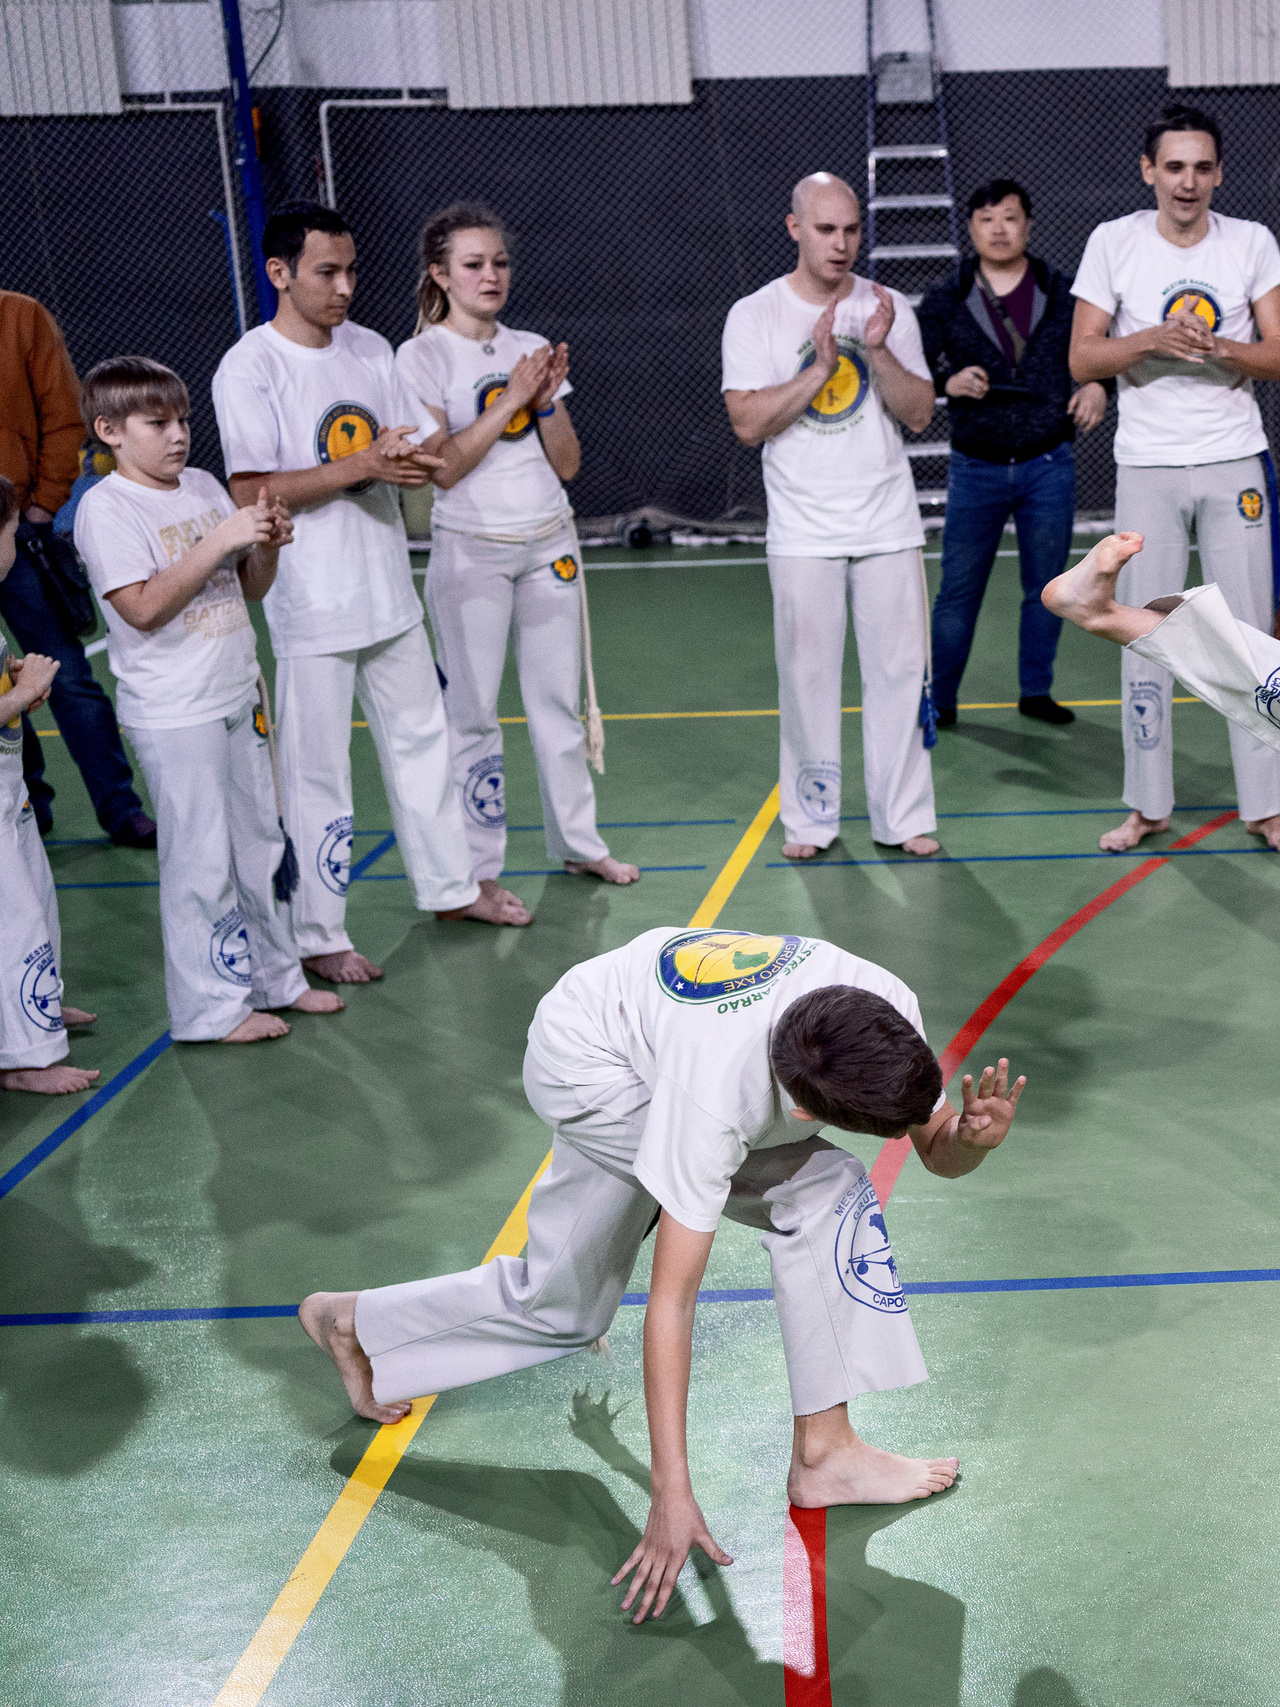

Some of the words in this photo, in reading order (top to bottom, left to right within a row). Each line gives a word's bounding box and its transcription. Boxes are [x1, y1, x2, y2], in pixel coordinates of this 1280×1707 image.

[759, 943, 797, 980] GRUPO
[783, 942, 822, 977] ESTRE
[834, 1172, 870, 1217] MESTRE
[853, 1189, 877, 1221] GRUP
